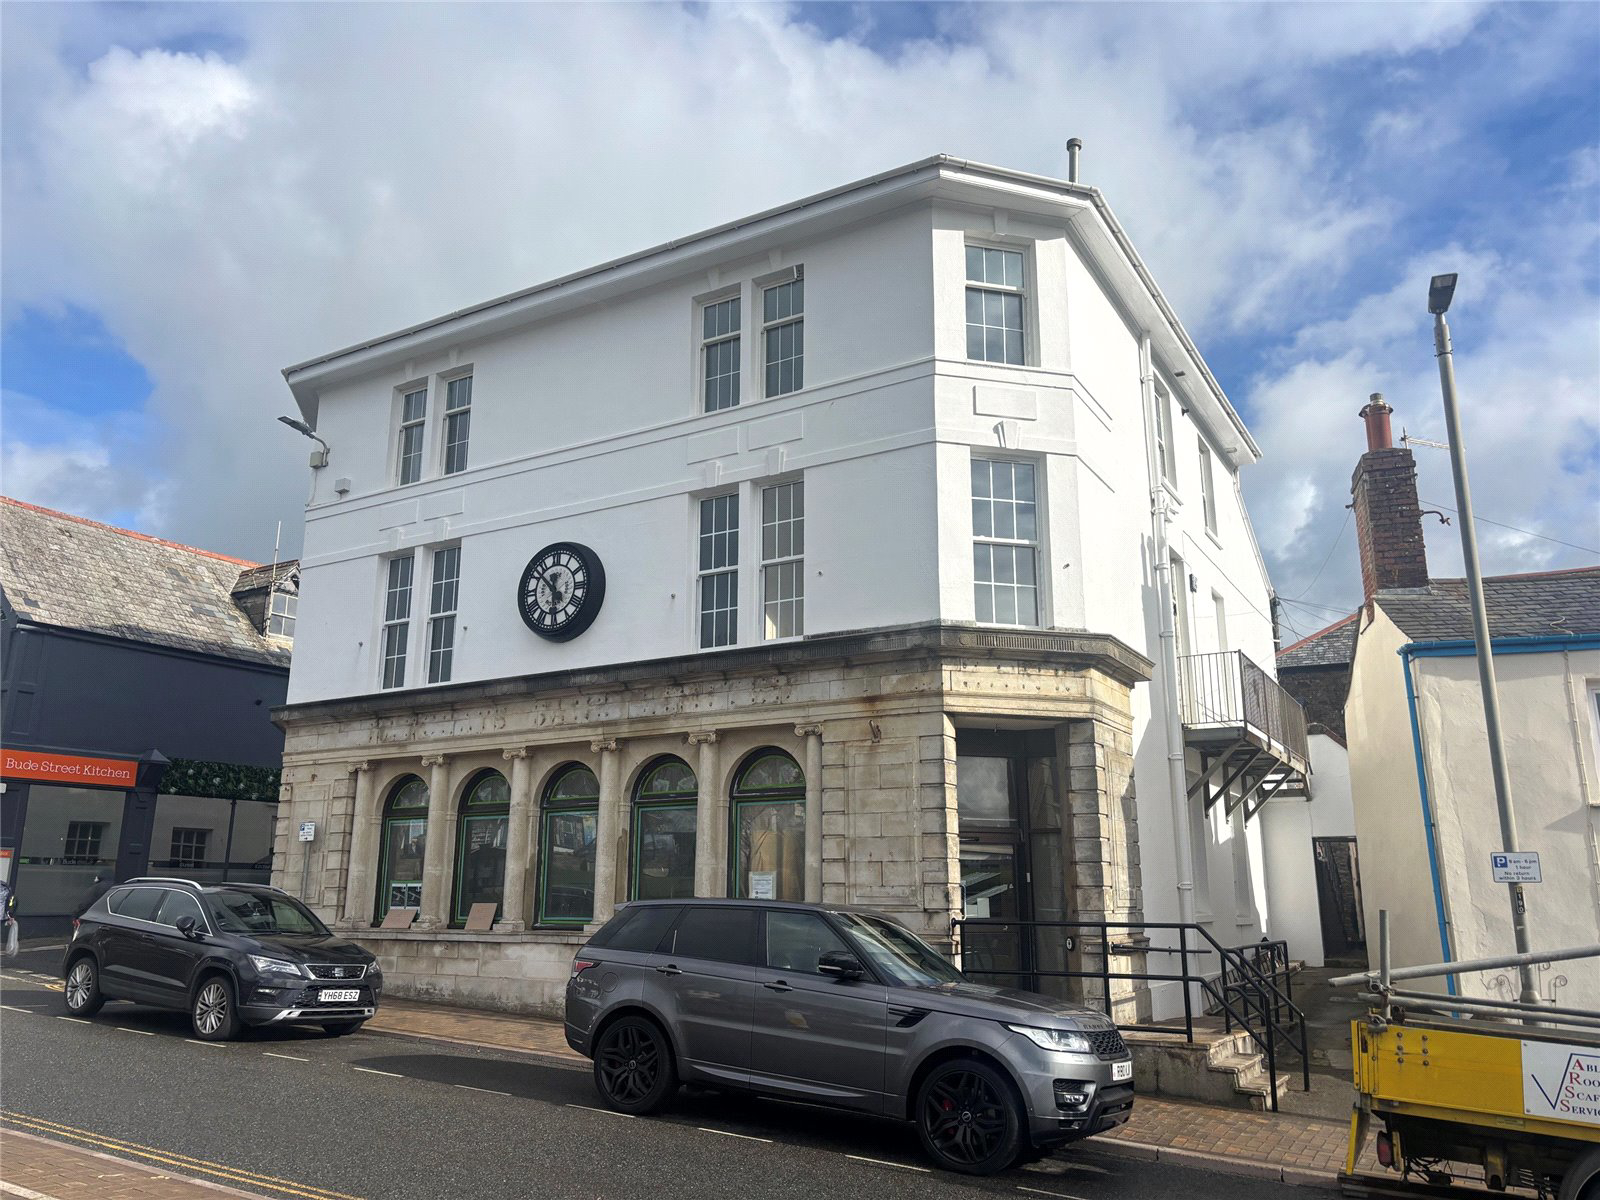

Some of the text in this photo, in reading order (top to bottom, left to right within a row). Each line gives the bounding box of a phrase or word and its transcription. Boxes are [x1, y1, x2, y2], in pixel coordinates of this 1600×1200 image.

[5, 757, 131, 779] Bude Street Kitchen
[1496, 857, 1506, 867] P
[323, 991, 359, 1000] YH68 ESZ
